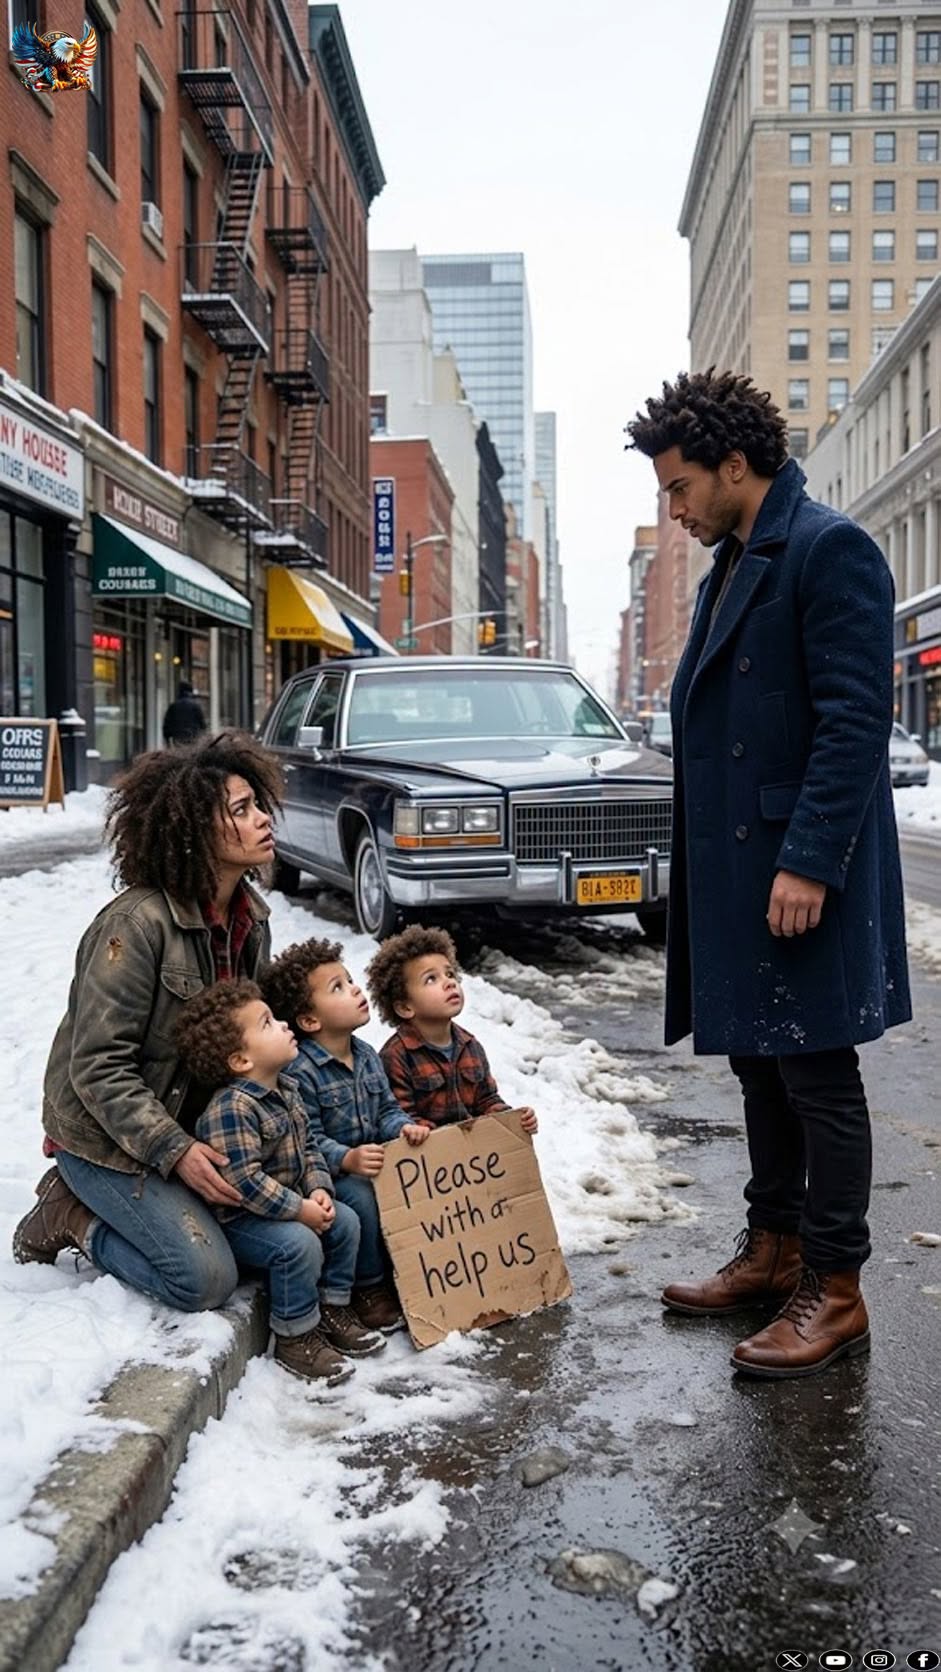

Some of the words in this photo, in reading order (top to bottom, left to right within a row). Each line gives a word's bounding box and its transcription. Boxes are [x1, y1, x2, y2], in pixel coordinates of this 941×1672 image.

[395, 1152, 506, 1209] Please
[421, 1196, 485, 1242] with
[419, 1242, 488, 1298] help
[498, 1232, 536, 1268] us
